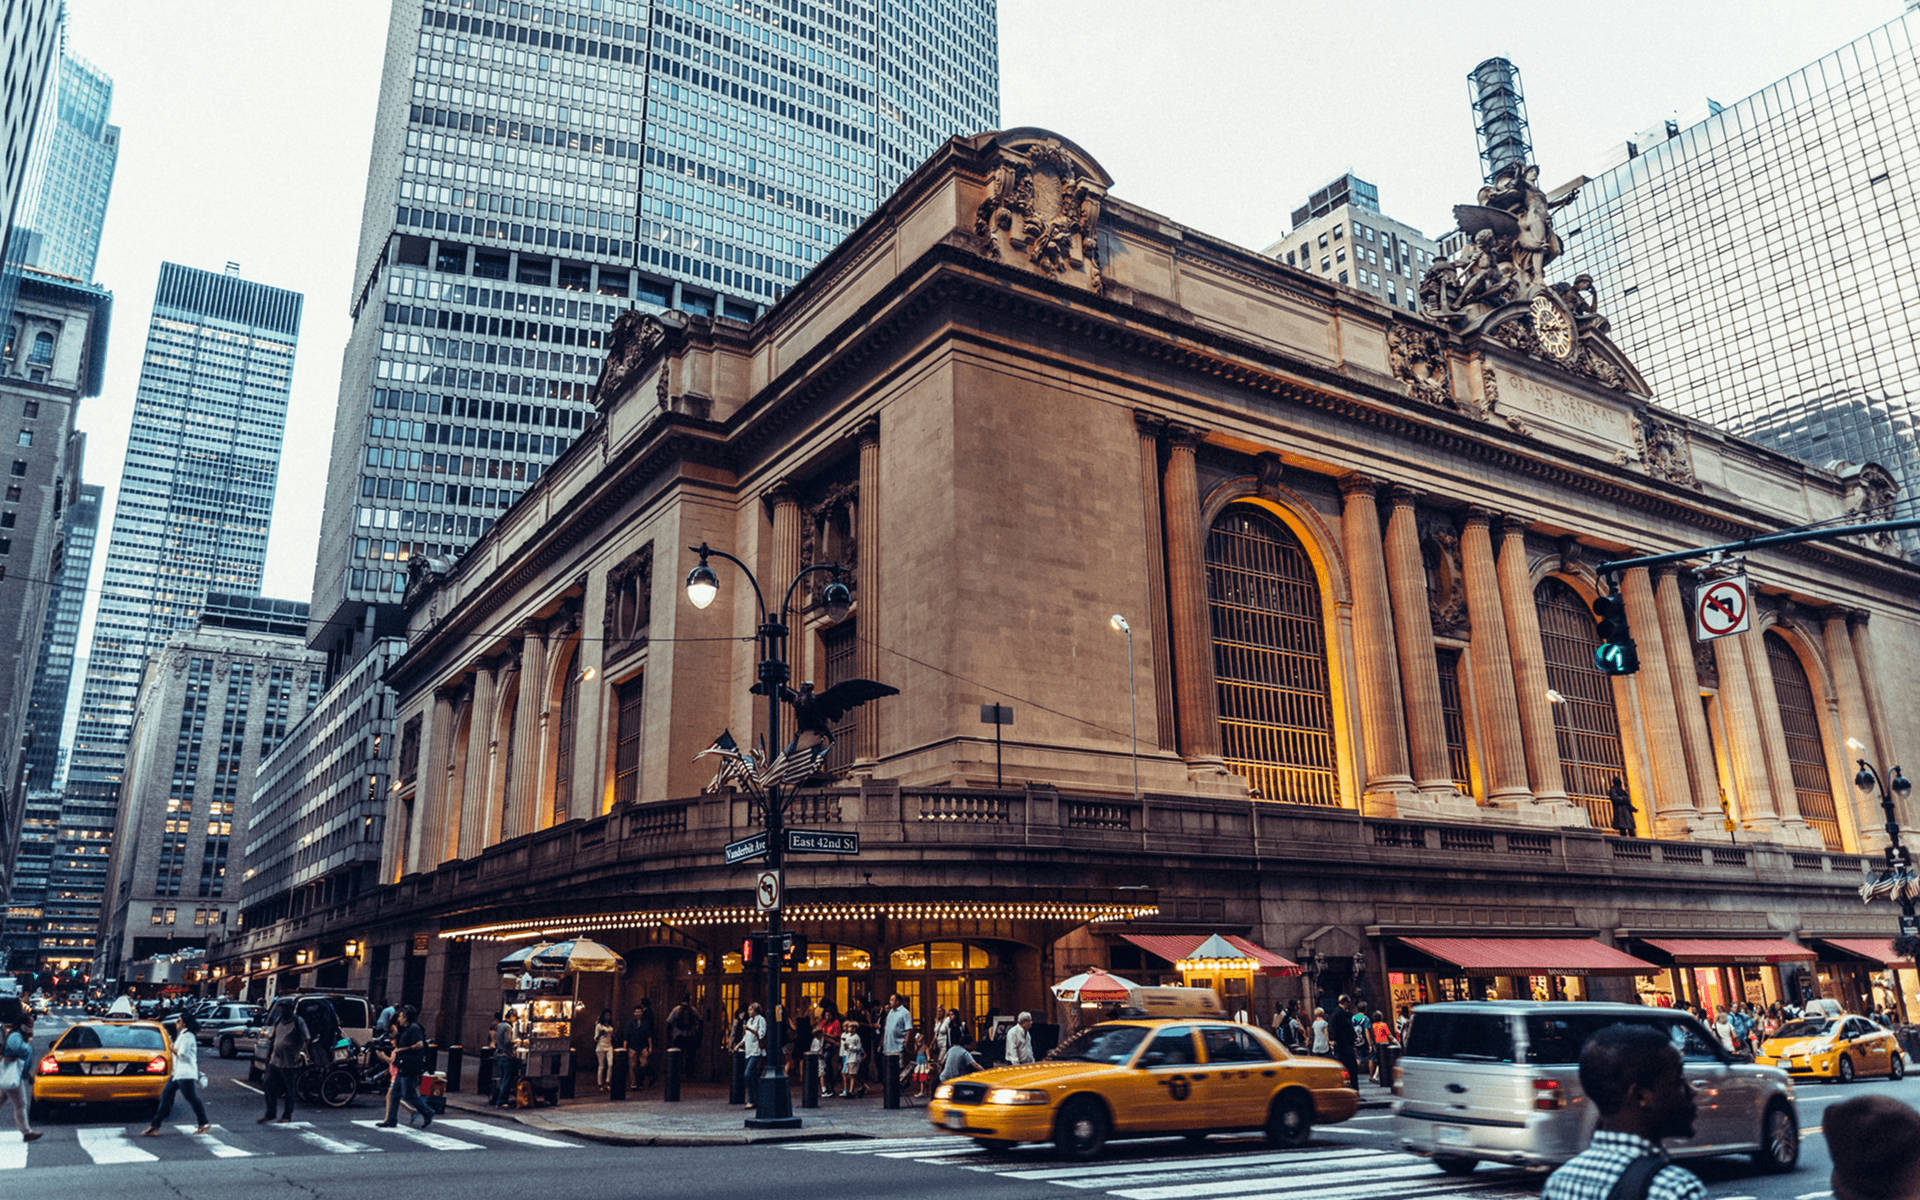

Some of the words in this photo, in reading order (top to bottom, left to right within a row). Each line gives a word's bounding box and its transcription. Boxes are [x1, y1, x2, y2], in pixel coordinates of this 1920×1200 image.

[1509, 375, 1554, 401] GRAND
[1560, 394, 1616, 424] CENTRAL
[1535, 398, 1595, 429] TERMINAL
[792, 835, 815, 848] East
[817, 838, 841, 849] 42nd
[843, 839, 854, 849] St
[726, 843, 754, 859] Vanderbilt
[1393, 988, 1417, 1002] SAVE
